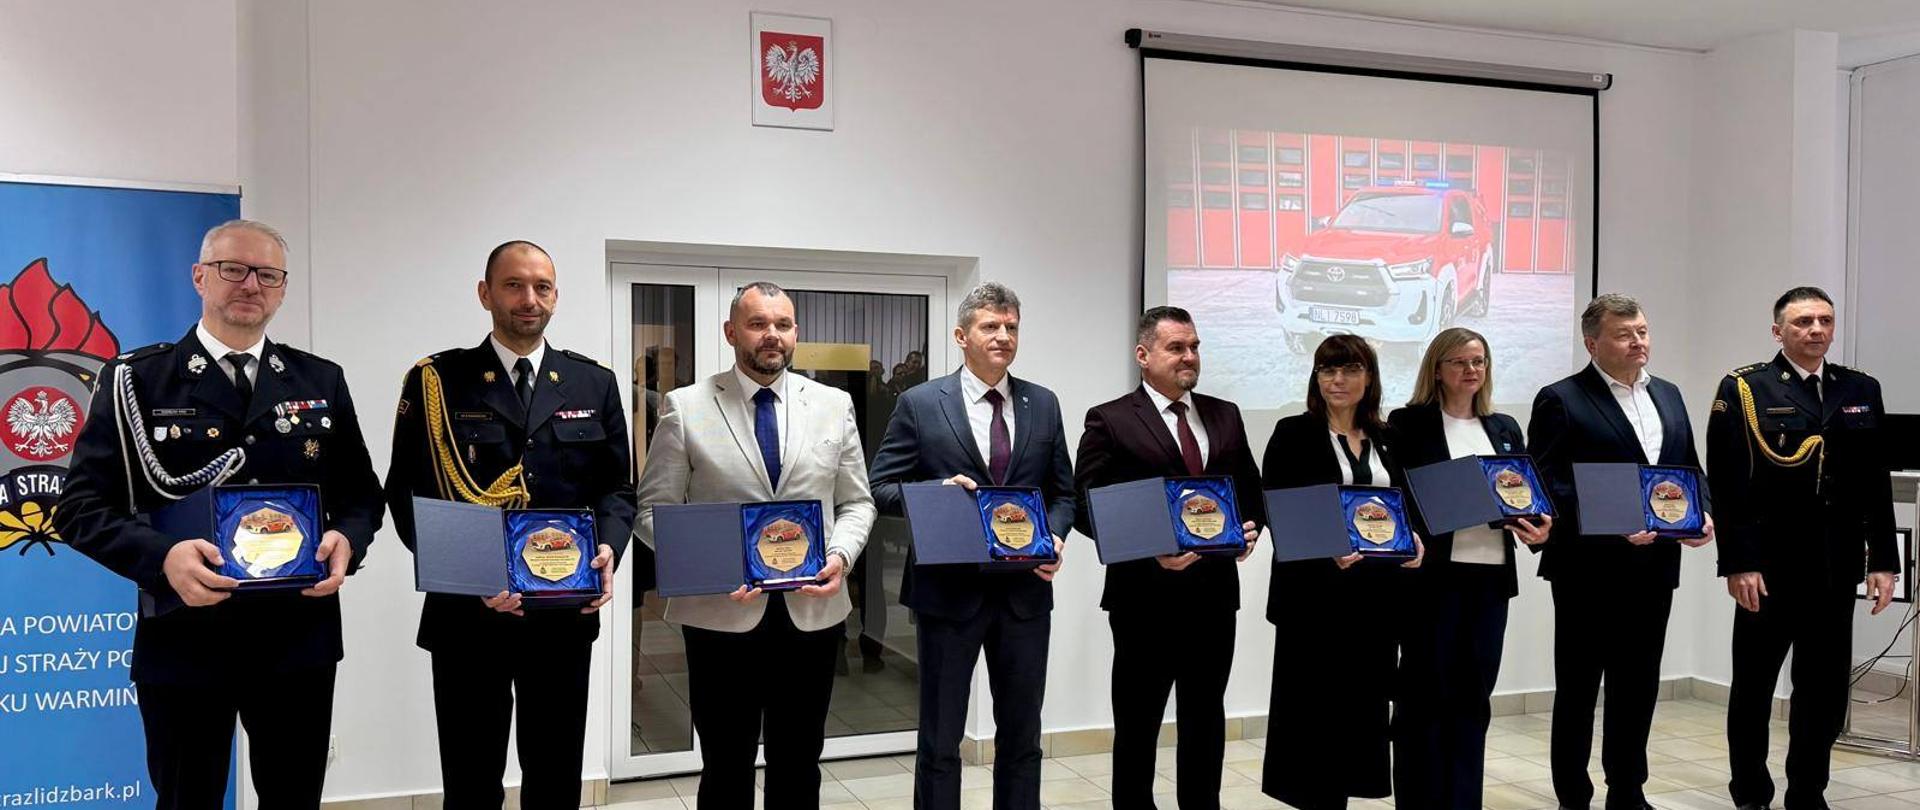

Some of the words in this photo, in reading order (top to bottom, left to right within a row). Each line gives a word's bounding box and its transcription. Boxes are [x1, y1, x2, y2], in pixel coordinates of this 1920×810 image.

[0, 617, 17, 636] A
[15, 647, 101, 673] STRAŻY
[34, 682, 139, 711] WARMIŃ
[0, 780, 140, 807] razlidzbark.pl
